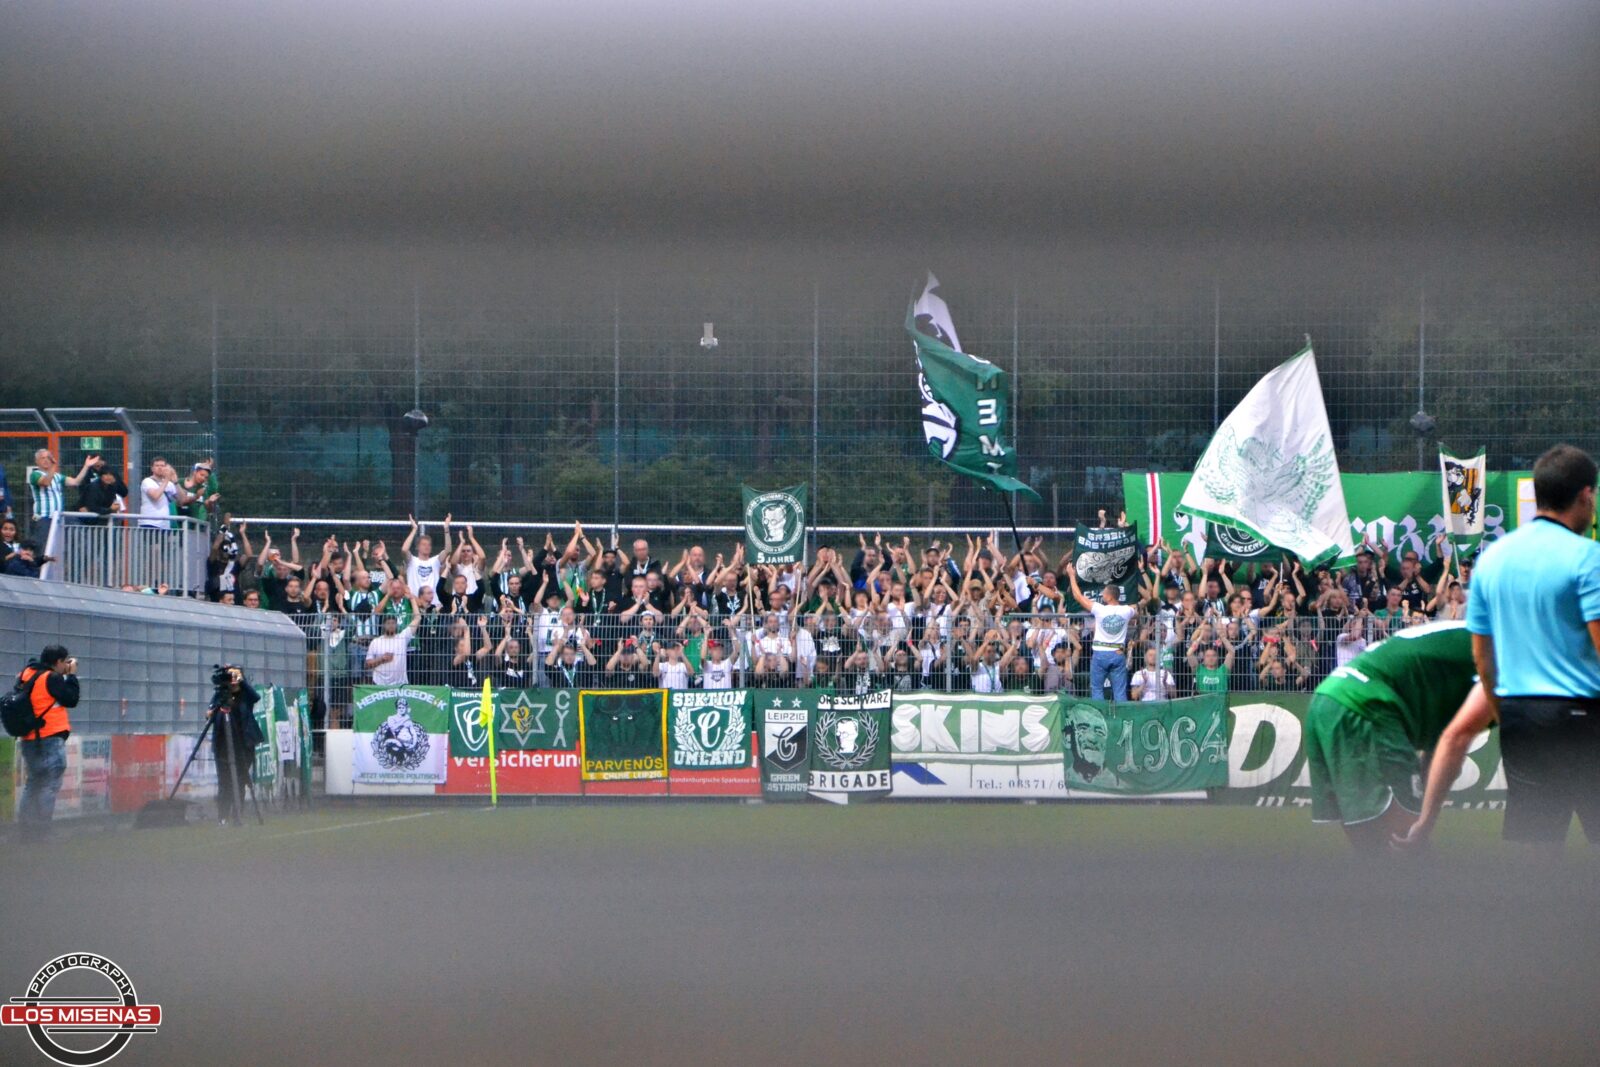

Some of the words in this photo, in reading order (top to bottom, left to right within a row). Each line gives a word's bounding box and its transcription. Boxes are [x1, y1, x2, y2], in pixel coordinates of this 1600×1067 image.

[757, 552, 765, 564] 5
[766, 555, 795, 564] JAHRE
[356, 688, 447, 711] HERRENGEDEK
[672, 690, 747, 707] SEKTION
[767, 712, 805, 721] LEIPZIG
[891, 704, 1051, 752] SKINS
[1116, 711, 1228, 774] 1964
[586, 756, 664, 771] PARVENÜS
[674, 749, 746, 766] UMLAND
[770, 774, 801, 783] GREEN
[808, 773, 888, 788] BRIGADE
